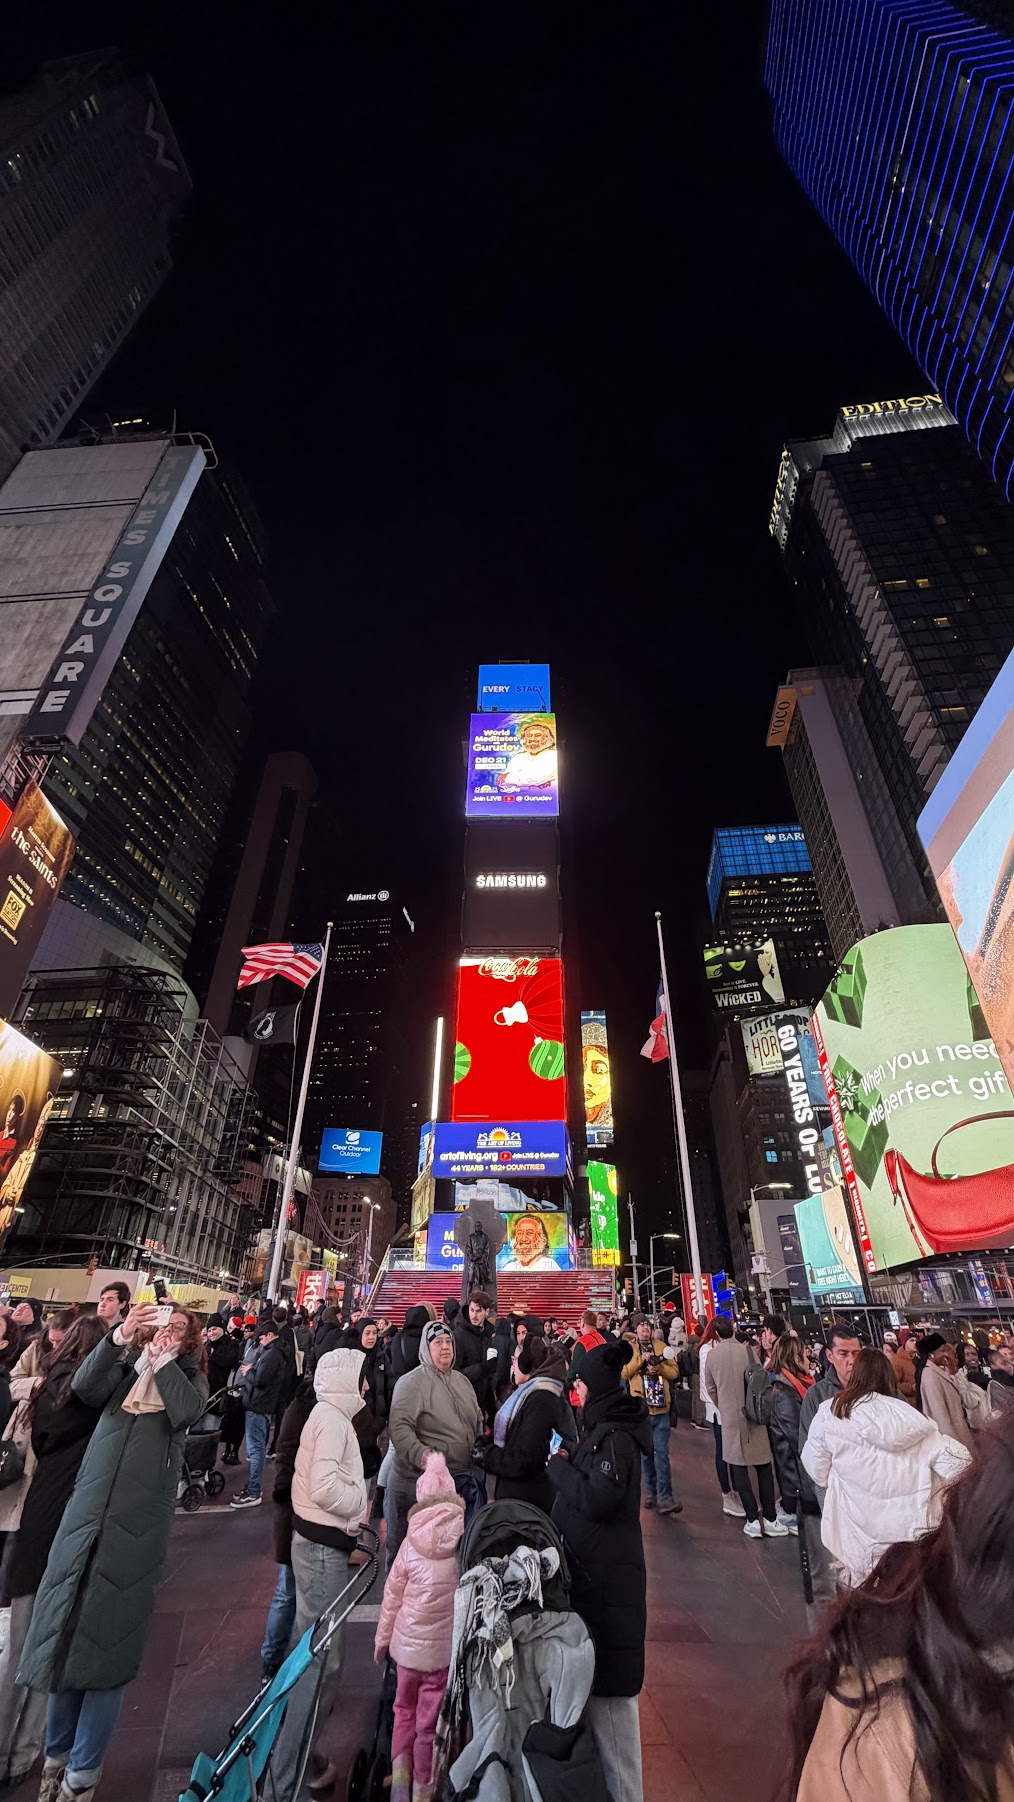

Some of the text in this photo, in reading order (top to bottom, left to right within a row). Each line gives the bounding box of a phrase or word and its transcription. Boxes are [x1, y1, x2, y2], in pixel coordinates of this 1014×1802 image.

[840, 394, 943, 417] EDITION
[39, 561, 132, 713] SQUARE
[482, 685, 544, 693] EVERY STACY
[770, 701, 791, 737] VOCO
[472, 743, 520, 752] Gurudev
[10, 826, 30, 857] the
[476, 874, 547, 889] SAMSUNG
[7, 897, 23, 913] FOX
[346, 893, 377, 902] Allianz
[778, 1024, 797, 1051] 60
[861, 1064, 886, 1096] When
[886, 1048, 930, 1080] you
[784, 1052, 814, 1124] YEARS
[882, 1074, 962, 1121] perfect
[822, 1061, 836, 1092] FREE
[830, 1095, 854, 1173] CHOCOLATE
[348, 1145, 371, 1153] Channel
[506, 1163, 545, 1171] COUNTRIES
